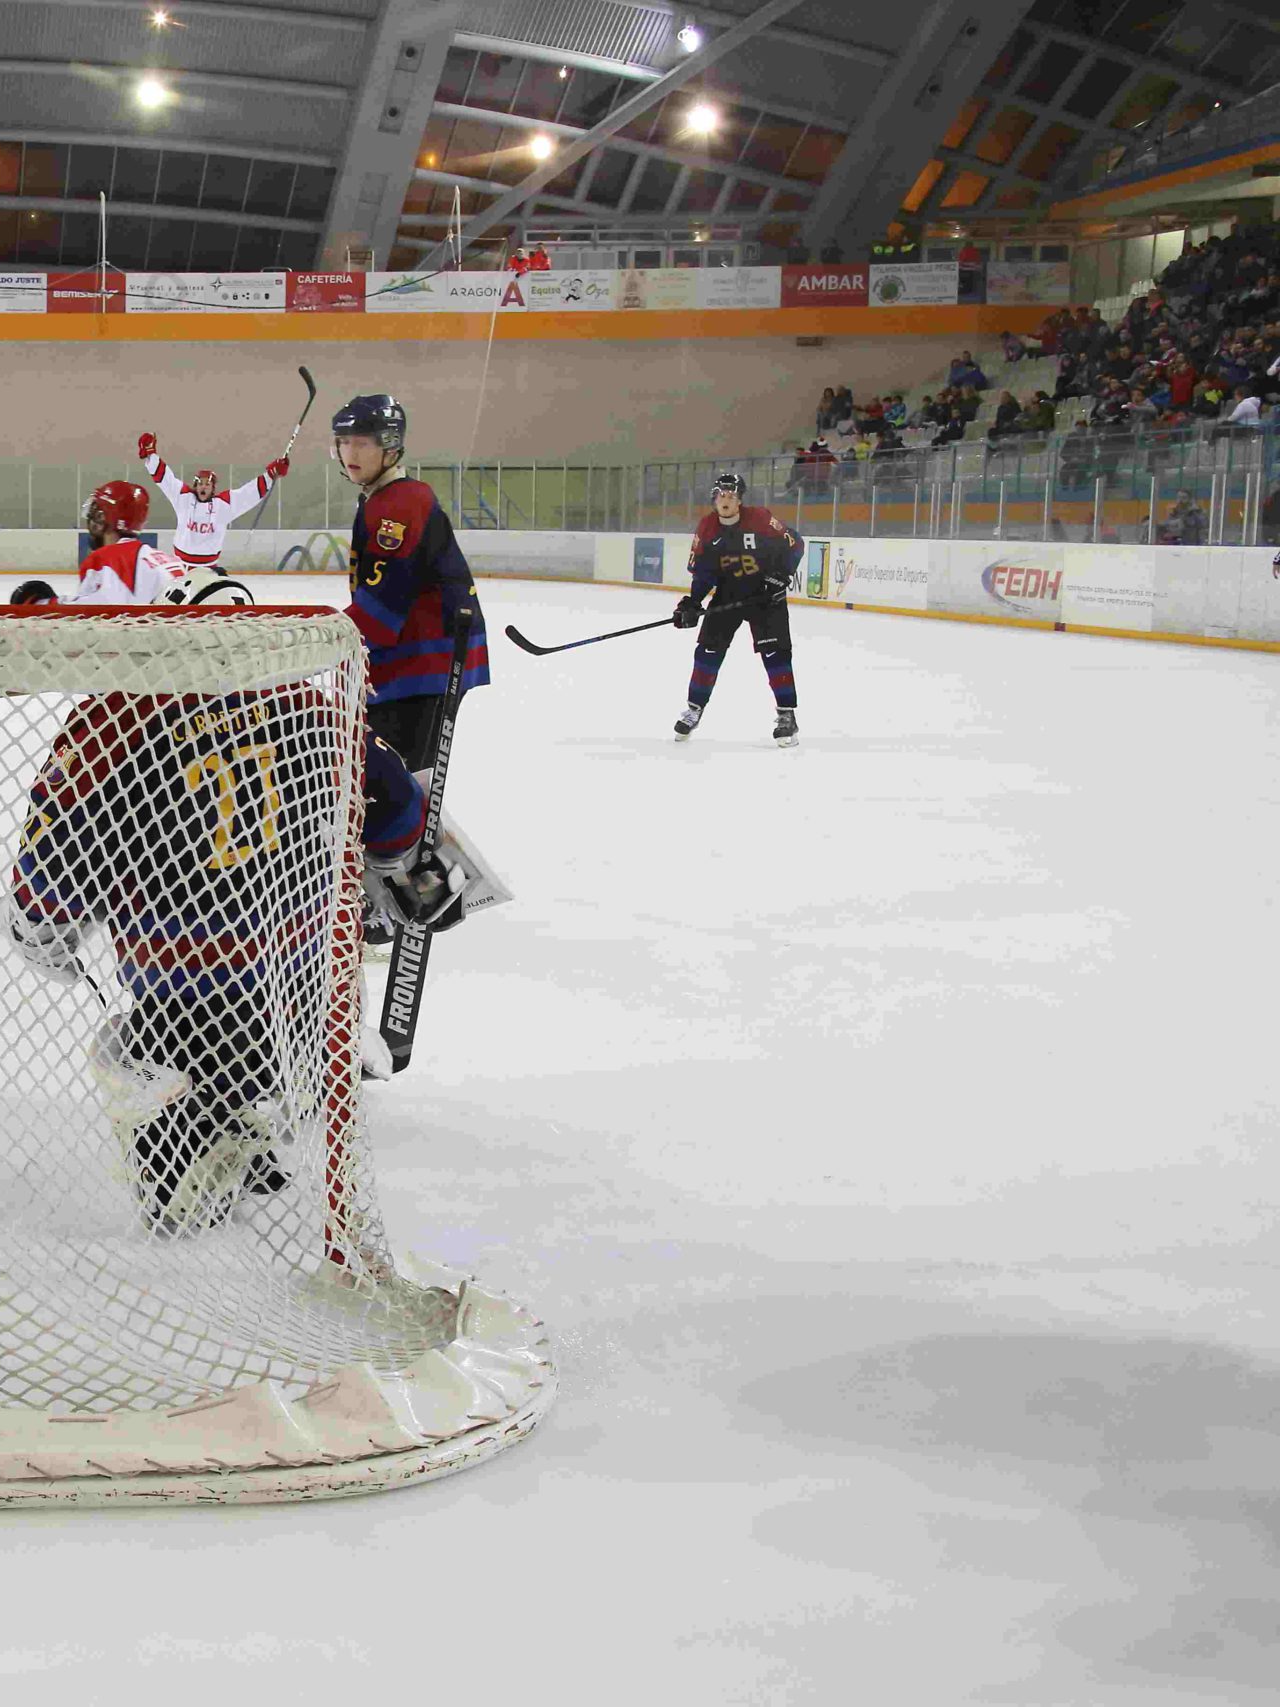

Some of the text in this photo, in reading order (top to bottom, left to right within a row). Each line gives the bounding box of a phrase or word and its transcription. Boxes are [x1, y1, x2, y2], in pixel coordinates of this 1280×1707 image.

[15, 277, 43, 285] JUSTE
[797, 273, 865, 291] AMBAR
[186, 516, 216, 534] JACA
[744, 533, 757, 550] A
[990, 565, 1062, 601] FEDH
[423, 717, 454, 846] FRONTIER
[387, 919, 428, 1036] FRONTIER
